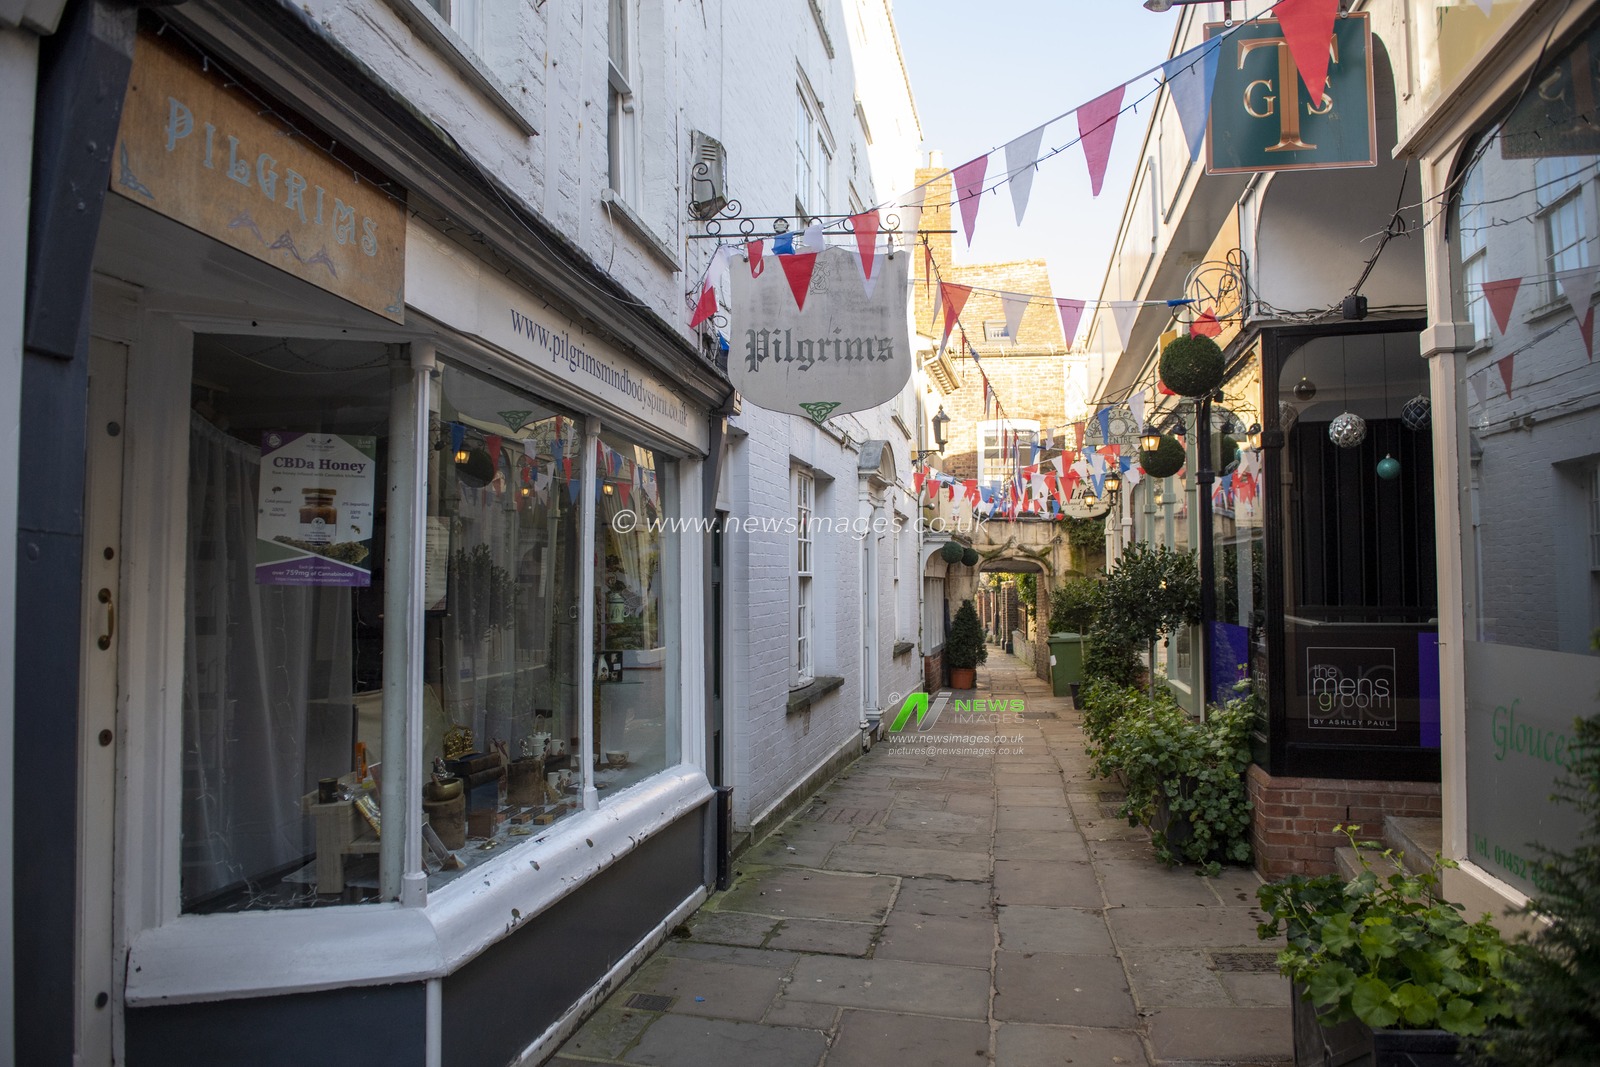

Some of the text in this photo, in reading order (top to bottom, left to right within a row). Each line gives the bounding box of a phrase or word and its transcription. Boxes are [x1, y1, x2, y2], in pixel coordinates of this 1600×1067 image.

[165, 96, 377, 257] PILGRIMS
[745, 328, 894, 373] Pilgrim's
[511, 309, 688, 428] www.pilgrimsmindbodyspirit.co.uk
[272, 456, 366, 474] CBDa Honey
[1313, 664, 1337, 678] the
[1313, 678, 1390, 697] mens
[1319, 693, 1390, 712] groom
[1494, 845, 1528, 880] 01452
